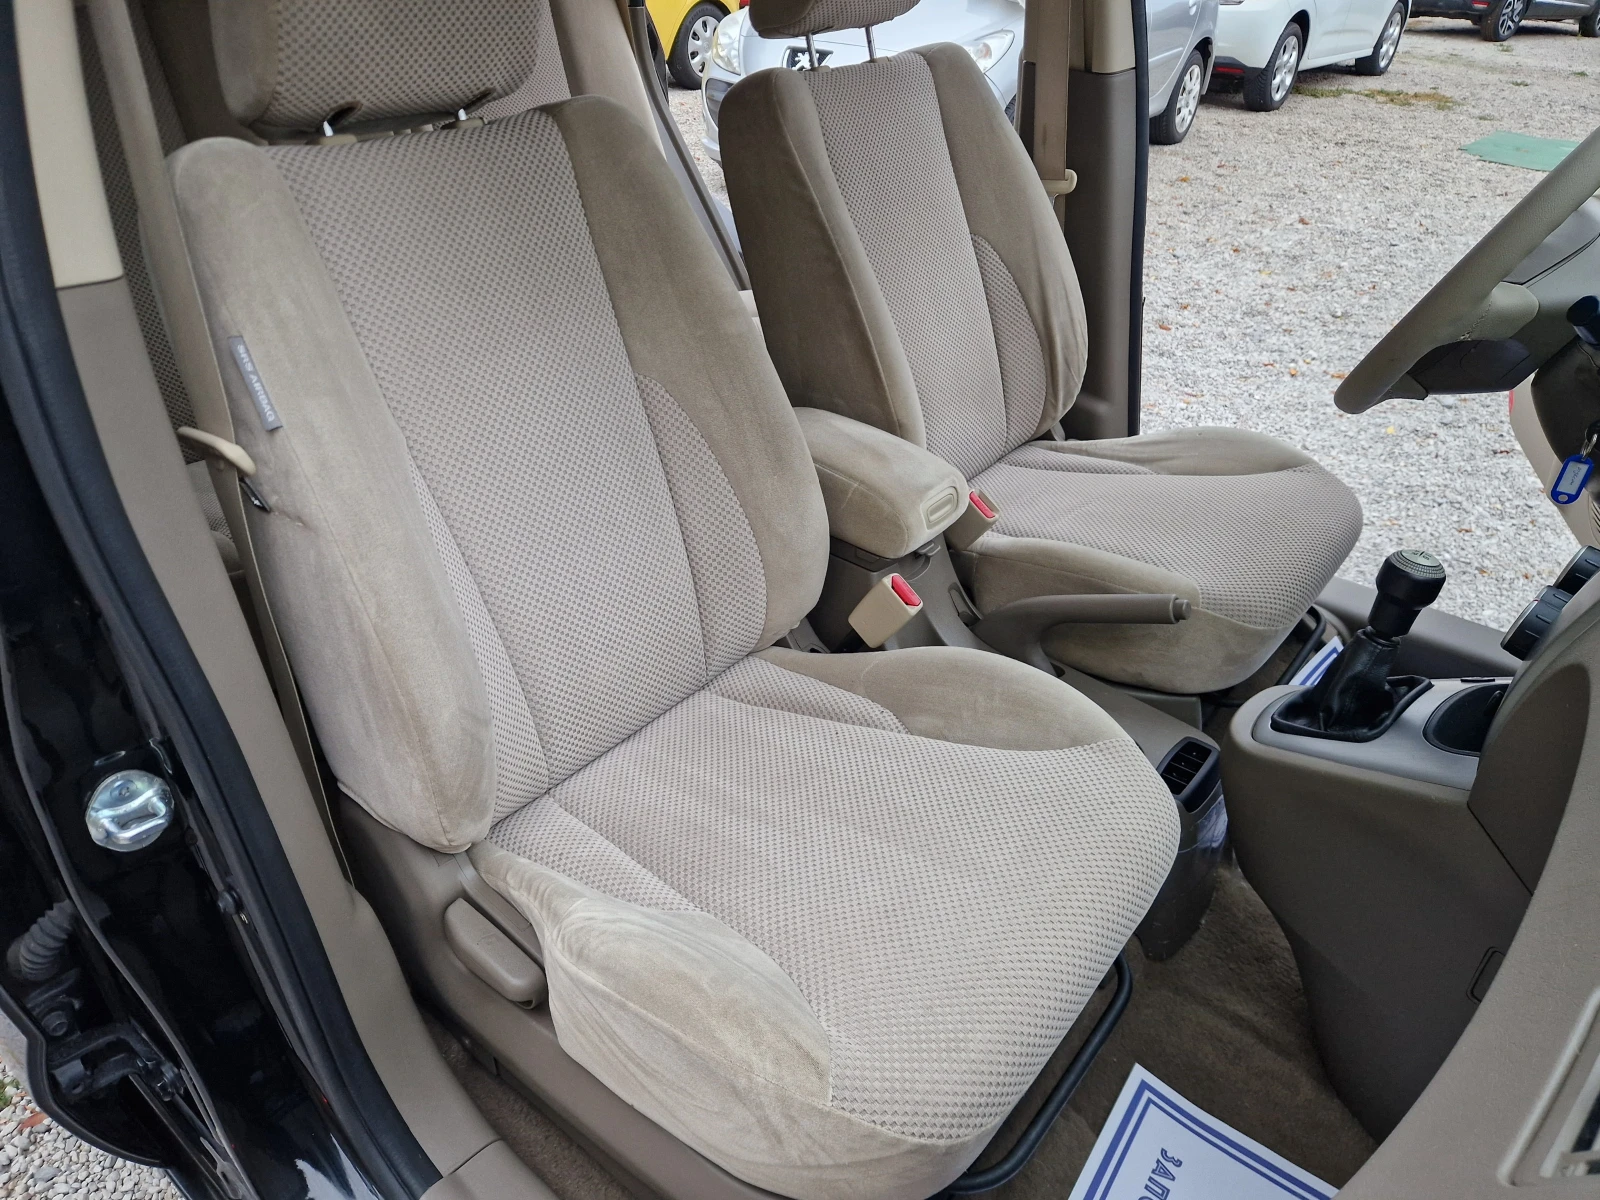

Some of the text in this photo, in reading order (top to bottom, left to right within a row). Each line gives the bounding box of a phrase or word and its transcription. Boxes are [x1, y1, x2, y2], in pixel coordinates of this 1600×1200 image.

[237, 344, 275, 422] SRS AIRBAG
[1138, 1147, 1183, 1200] ЗАП
